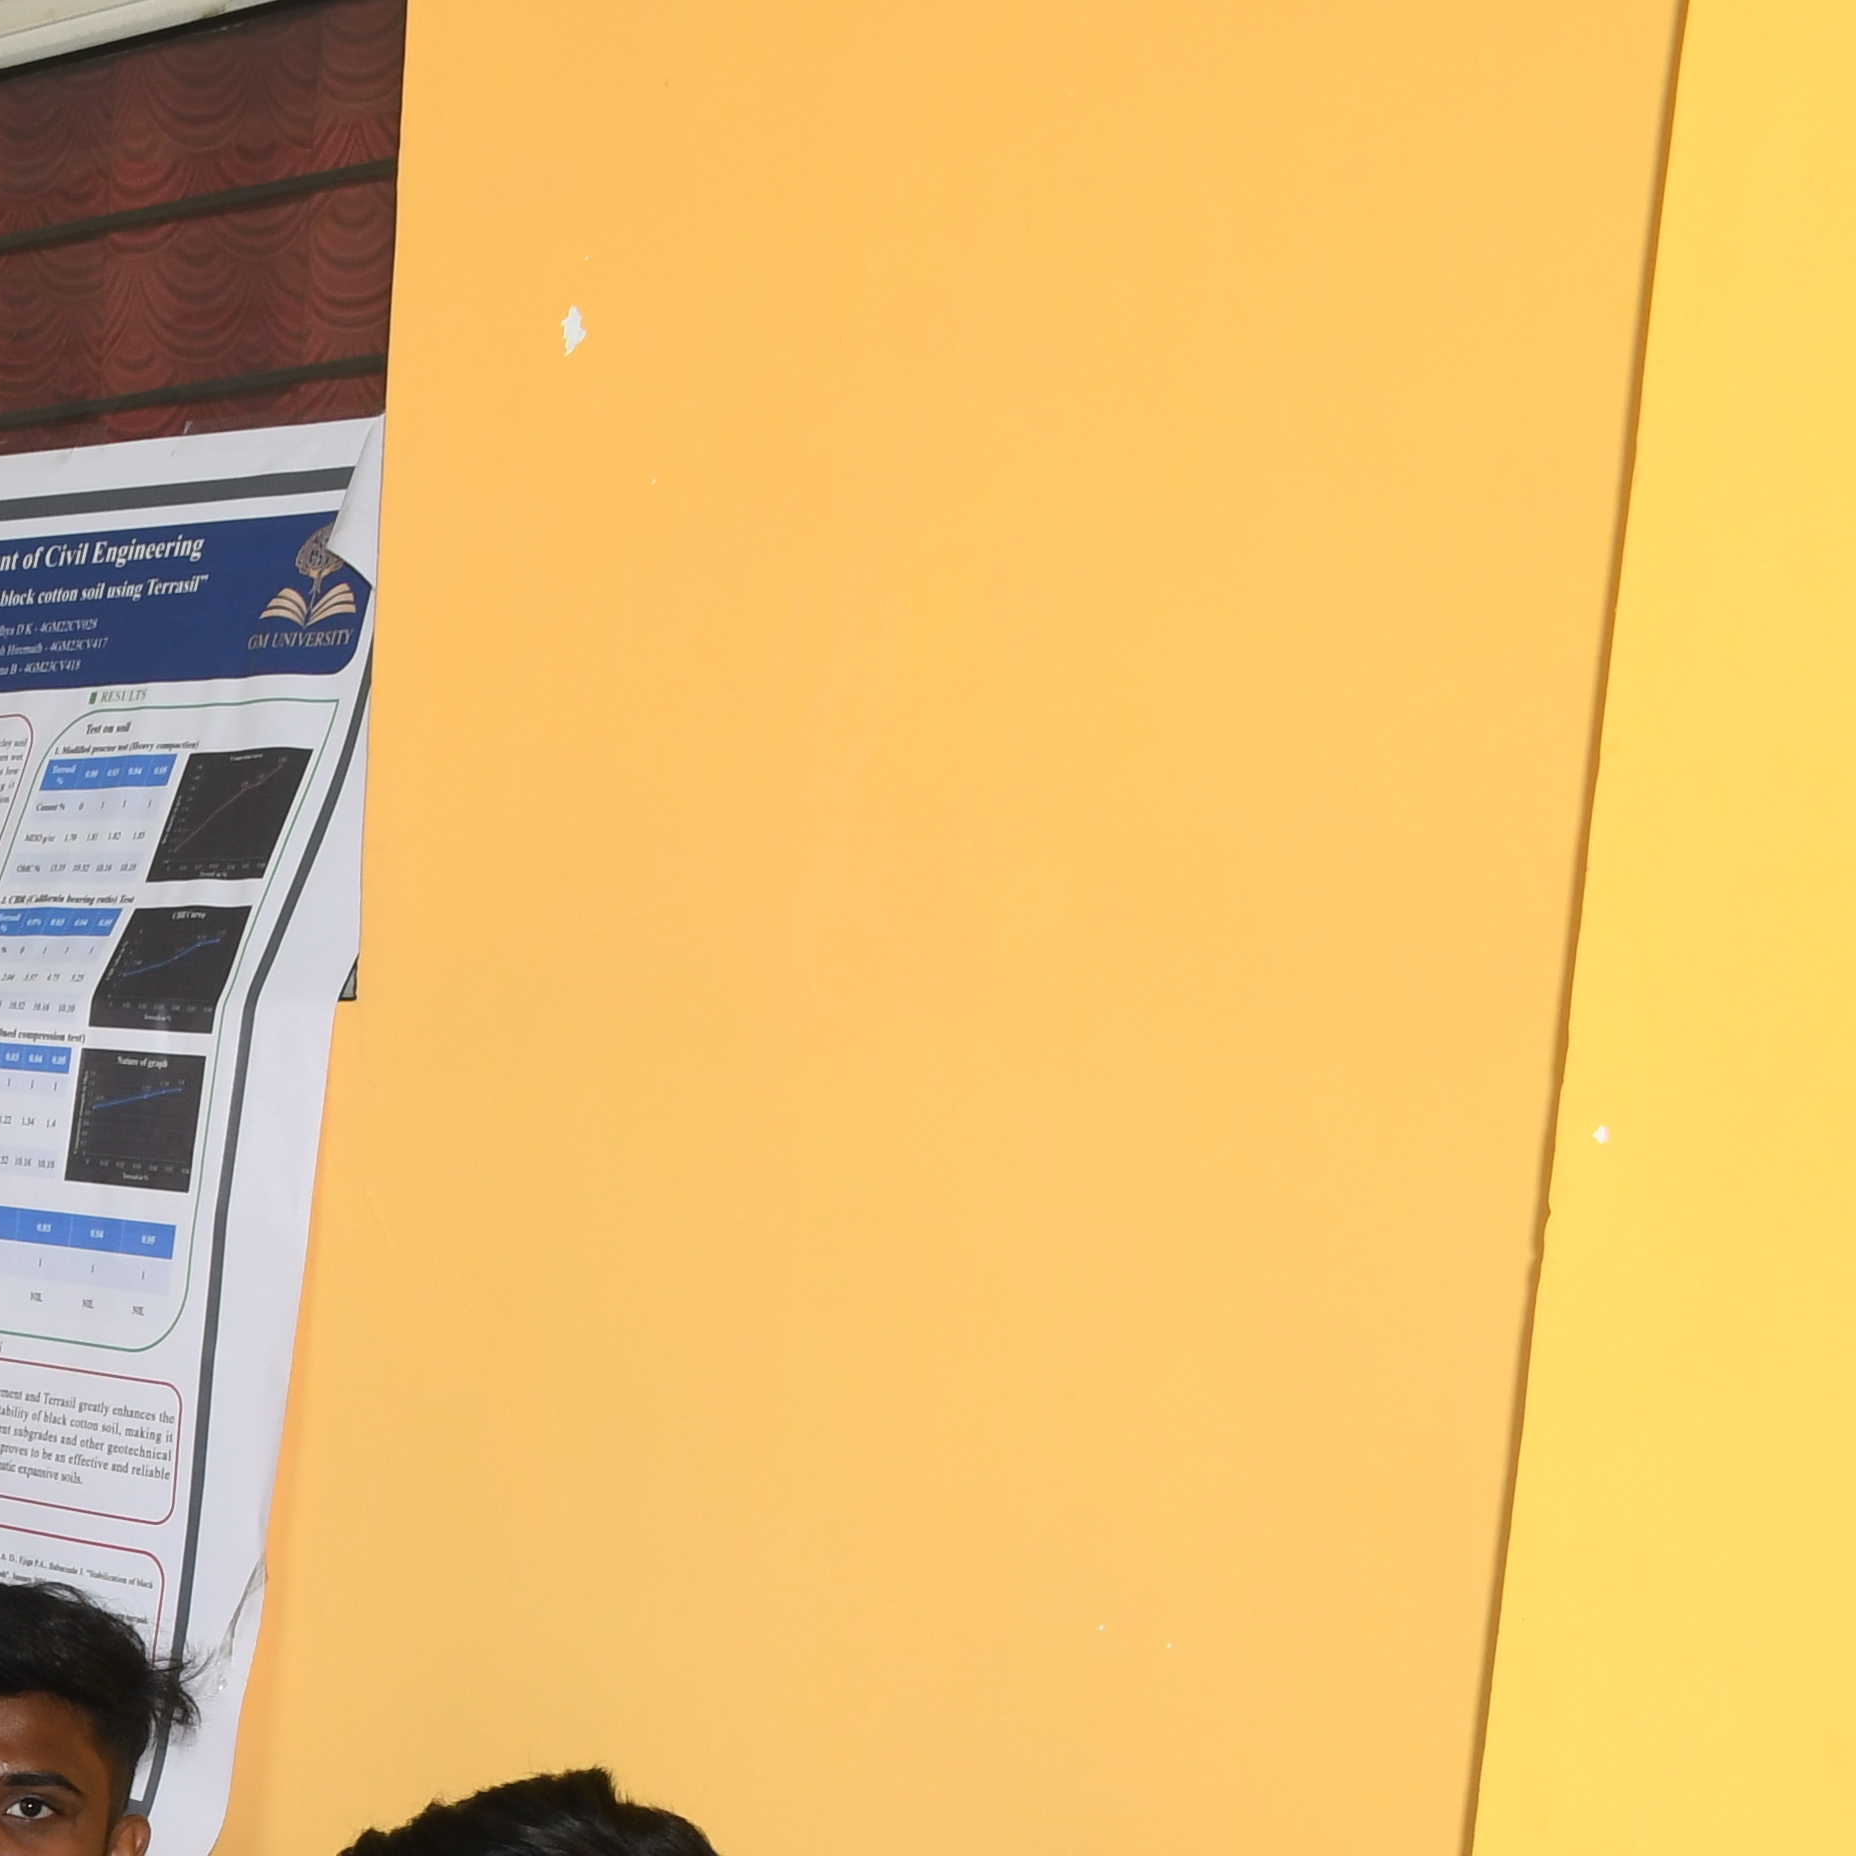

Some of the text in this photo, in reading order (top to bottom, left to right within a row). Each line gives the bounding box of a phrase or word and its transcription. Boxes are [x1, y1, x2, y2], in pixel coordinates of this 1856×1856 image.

[22, 546, 43, 569] of
[44, 542, 89, 567] Civil
[91, 539, 204, 568] Engineering
[0, 588, 35, 607] block
[37, 587, 78, 604] cotton
[80, 582, 105, 600] soil
[106, 580, 143, 601] using
[147, 574, 209, 595] Terrasil”
[247, 629, 353, 650] GM UNIVERSITY
[100, 688, 147, 703] RESULTS
[24, 1391, 41, 1403] and
[43, 1392, 76, 1409] Terrasil
[77, 1401, 110, 1416] greatly
[112, 1405, 156, 1421] enhances
[158, 1410, 175, 1424] the
[31, 1409, 43, 1422] of
[43, 1410, 67, 1426] black
[69, 1418, 98, 1431] cotton
[101, 1422, 122, 1436] soil,
[124, 1426, 162, 1444] making
[165, 1430, 173, 1443] it
[12, 1426, 57, 1443] subgrades
[60, 1434, 78, 1446] and
[79, 1436, 105, 1451] other
[106, 1443, 172, 1462] geotechnical
